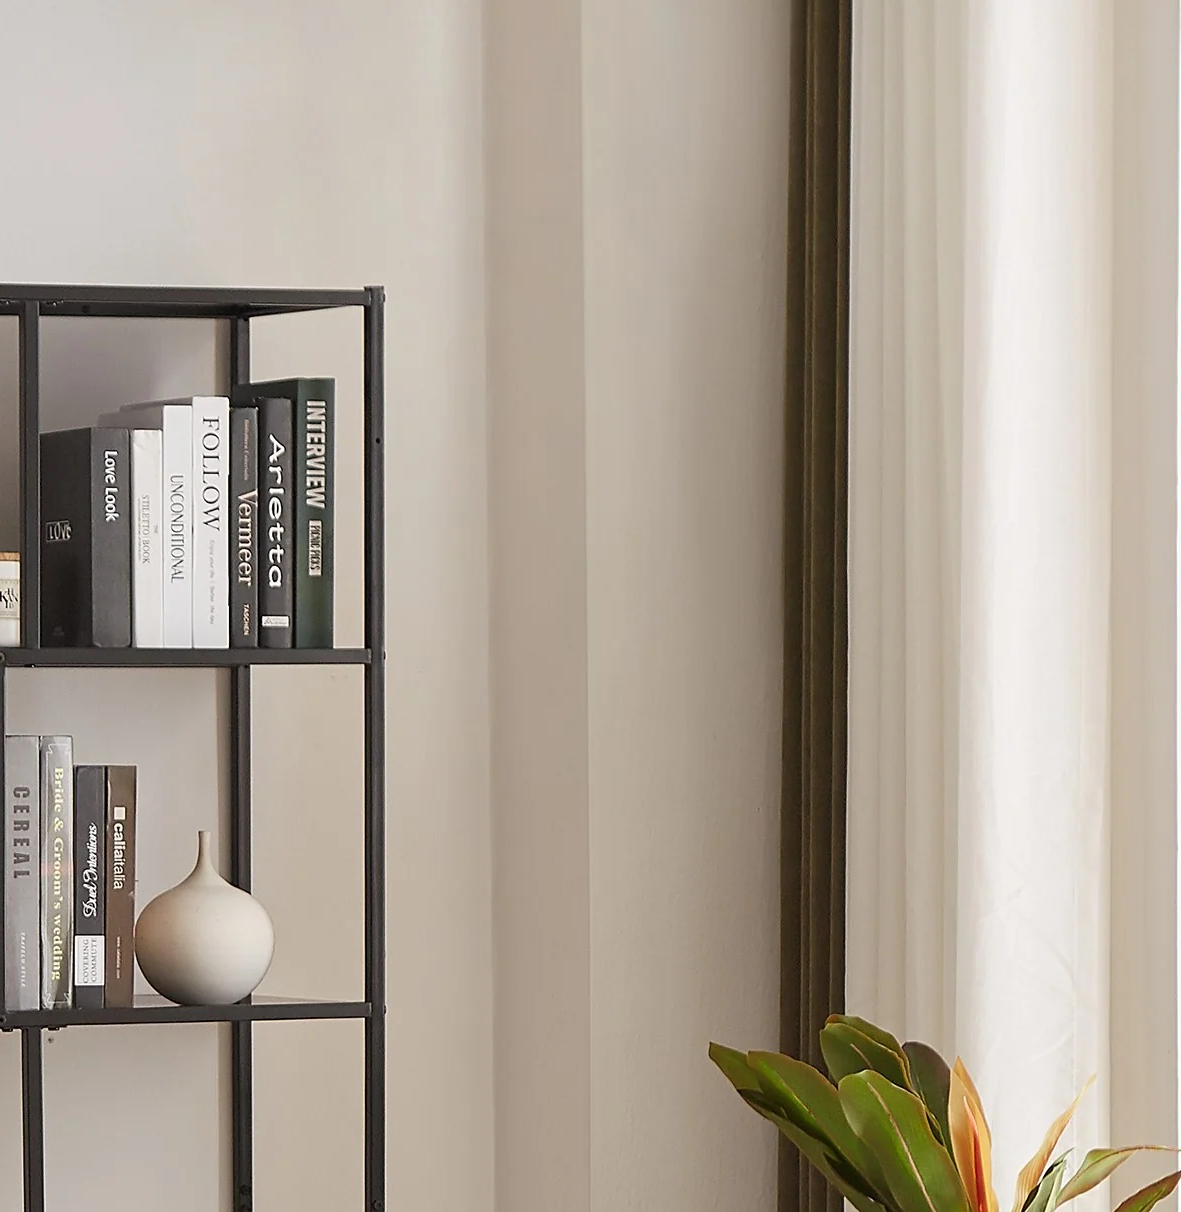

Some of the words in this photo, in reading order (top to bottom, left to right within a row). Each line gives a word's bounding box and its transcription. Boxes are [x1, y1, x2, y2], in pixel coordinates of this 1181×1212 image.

[104, 450, 118, 485] Love
[202, 415, 221, 532] FOLLOW
[306, 400, 326, 508] INTERVIEW
[105, 487, 120, 522] Look
[141, 494, 150, 536] STILETTO
[170, 474, 185, 583] UNCONDITIONAL
[268, 434, 286, 588] Arletta
[141, 539, 150, 564] BOOK
[238, 489, 258, 587] Vermeer
[54, 767, 64, 813] Bride
[13, 786, 31, 880] CEREAL
[53, 817, 64, 832] &
[83, 822, 98, 882] Intentions
[53, 837, 65, 909] Groom's
[113, 823, 126, 890] caliaitalia
[82, 882, 98, 917] Duel
[51, 914, 64, 981] wedding
[90, 937, 98, 982] COMMUTE
